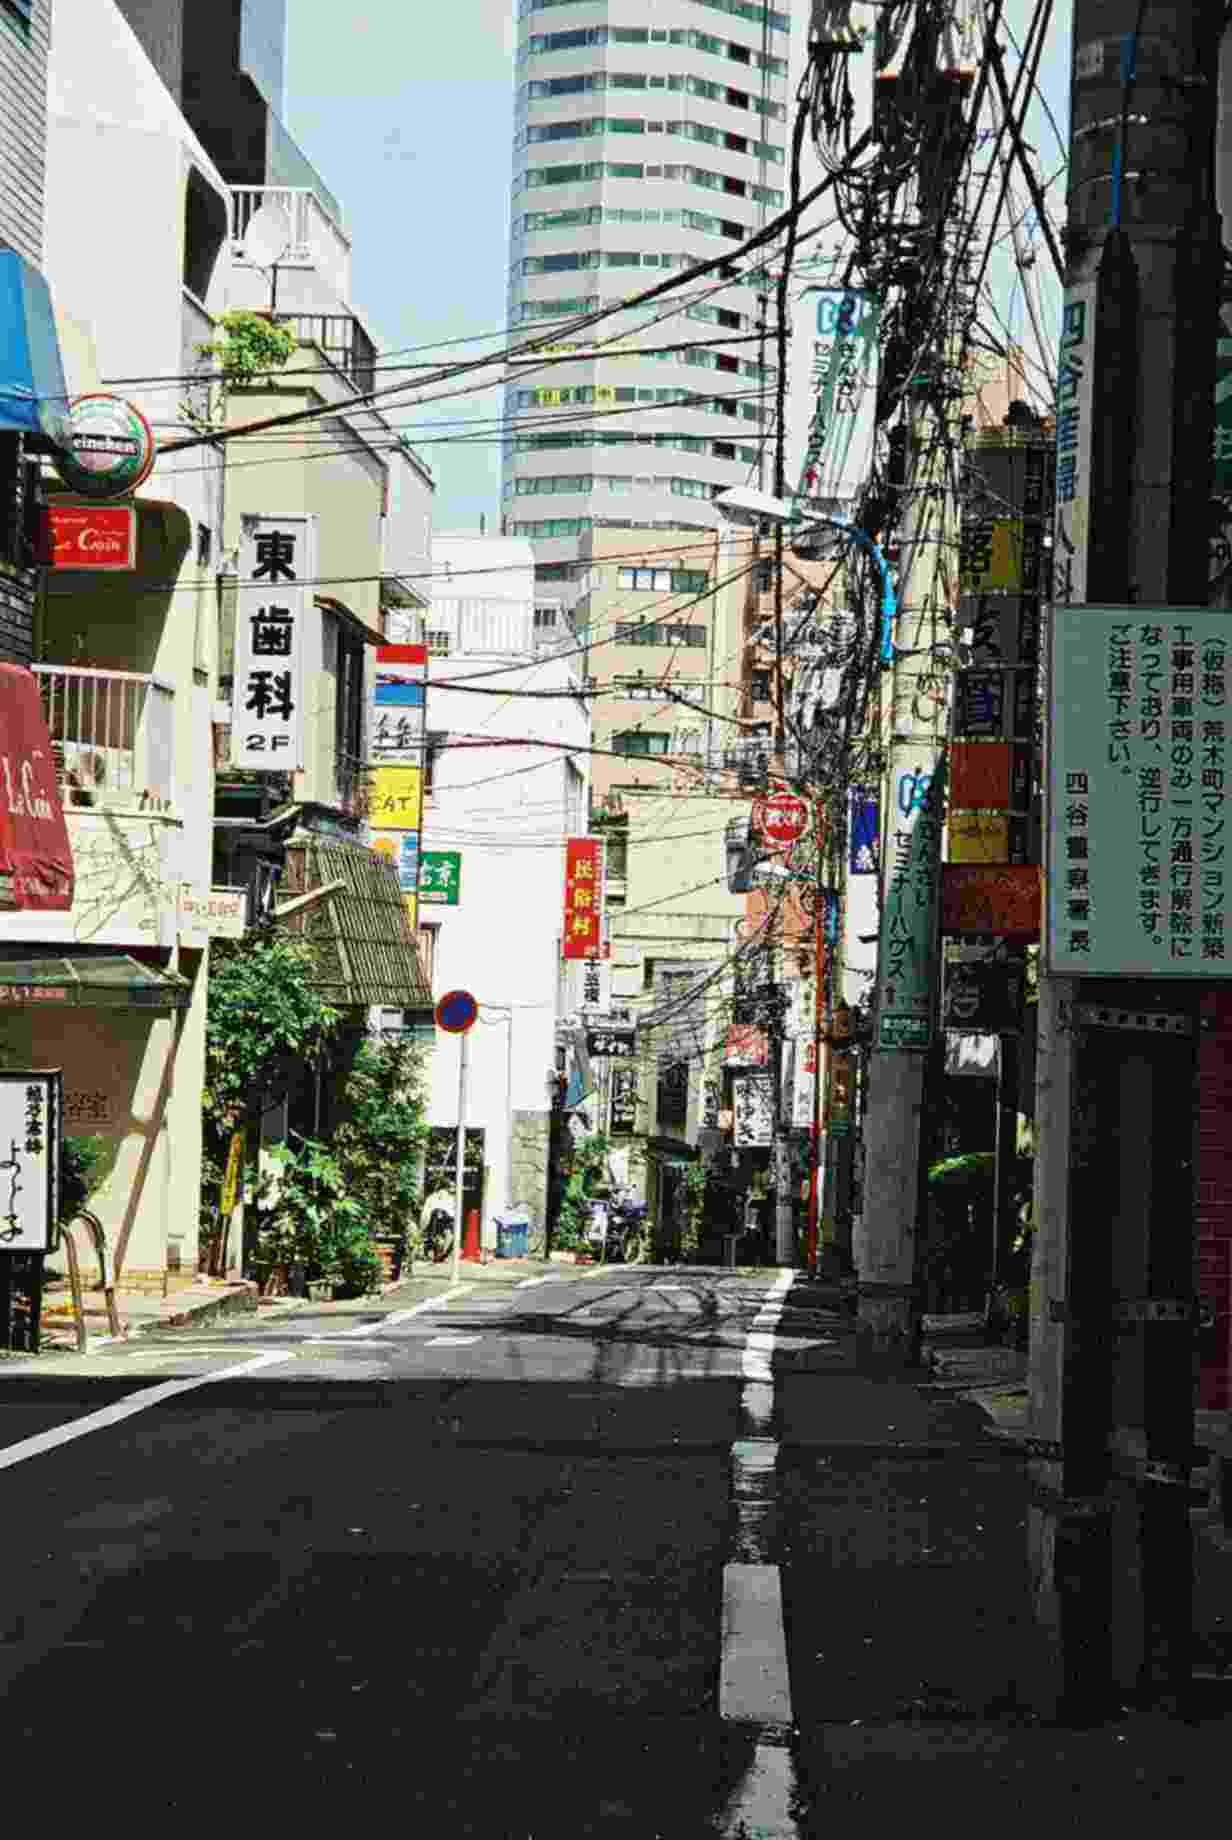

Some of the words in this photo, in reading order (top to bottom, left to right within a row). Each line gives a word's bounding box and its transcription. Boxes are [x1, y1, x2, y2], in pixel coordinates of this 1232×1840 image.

[245, 530, 297, 721] 東歯科
[1108, 623, 1133, 776] ご注意下さい。
[245, 734, 291, 752] 2F
[1139, 623, 1163, 946] なっており、逆行してきます。
[1170, 624, 1194, 959] 工事用車両のみ一方通行解除に
[887, 829, 914, 980] セミナーハウス
[1065, 771, 1090, 953] 四谷警察署長
